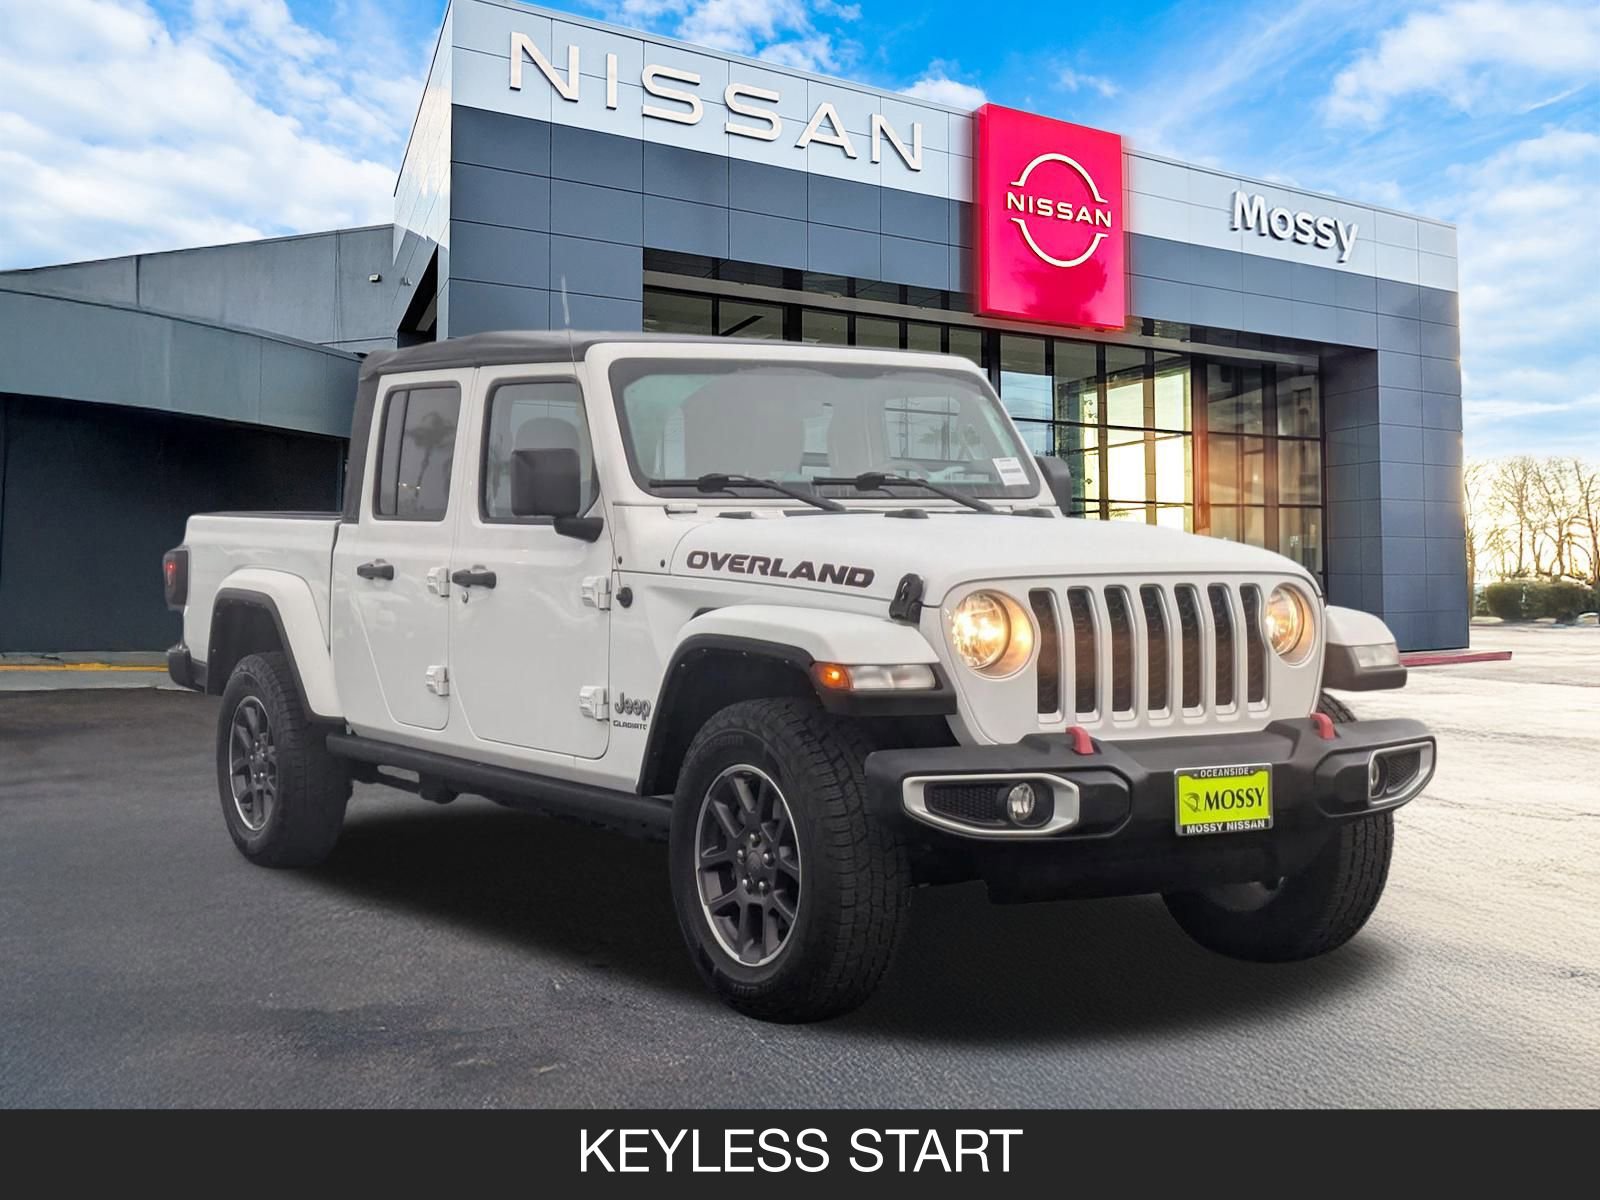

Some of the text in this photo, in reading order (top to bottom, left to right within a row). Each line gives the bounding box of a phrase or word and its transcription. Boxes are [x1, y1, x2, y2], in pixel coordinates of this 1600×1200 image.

[509, 31, 922, 171] NISSAN
[1007, 191, 1112, 228] NISSAN
[1231, 190, 1359, 263] Mossy
[687, 550, 875, 588] OVERLAND
[615, 691, 651, 721] Jeep
[1200, 767, 1249, 778] OCEANSIDE
[1204, 787, 1264, 812] MOSSY
[1187, 820, 1265, 834] MOSSY NISSAN
